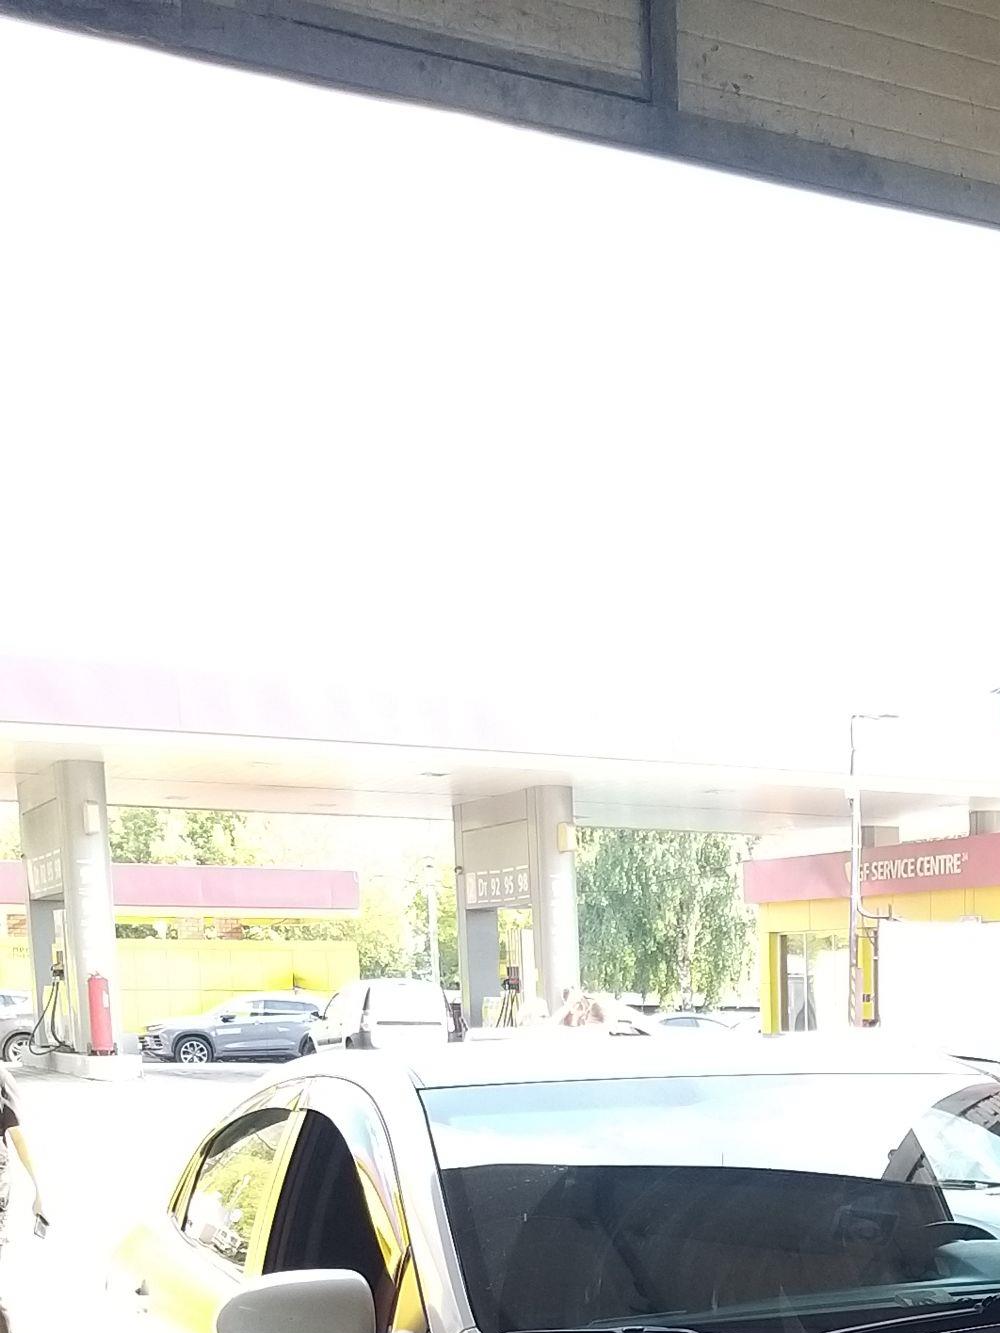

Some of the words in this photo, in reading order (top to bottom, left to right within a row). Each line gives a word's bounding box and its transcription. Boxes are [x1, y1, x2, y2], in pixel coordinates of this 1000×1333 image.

[871, 858, 915, 881] SERVICE
[916, 853, 961, 877] CENTRE
[490, 877, 501, 896] 92
[504, 875, 514, 894] 95
[517, 872, 529, 892] 98
